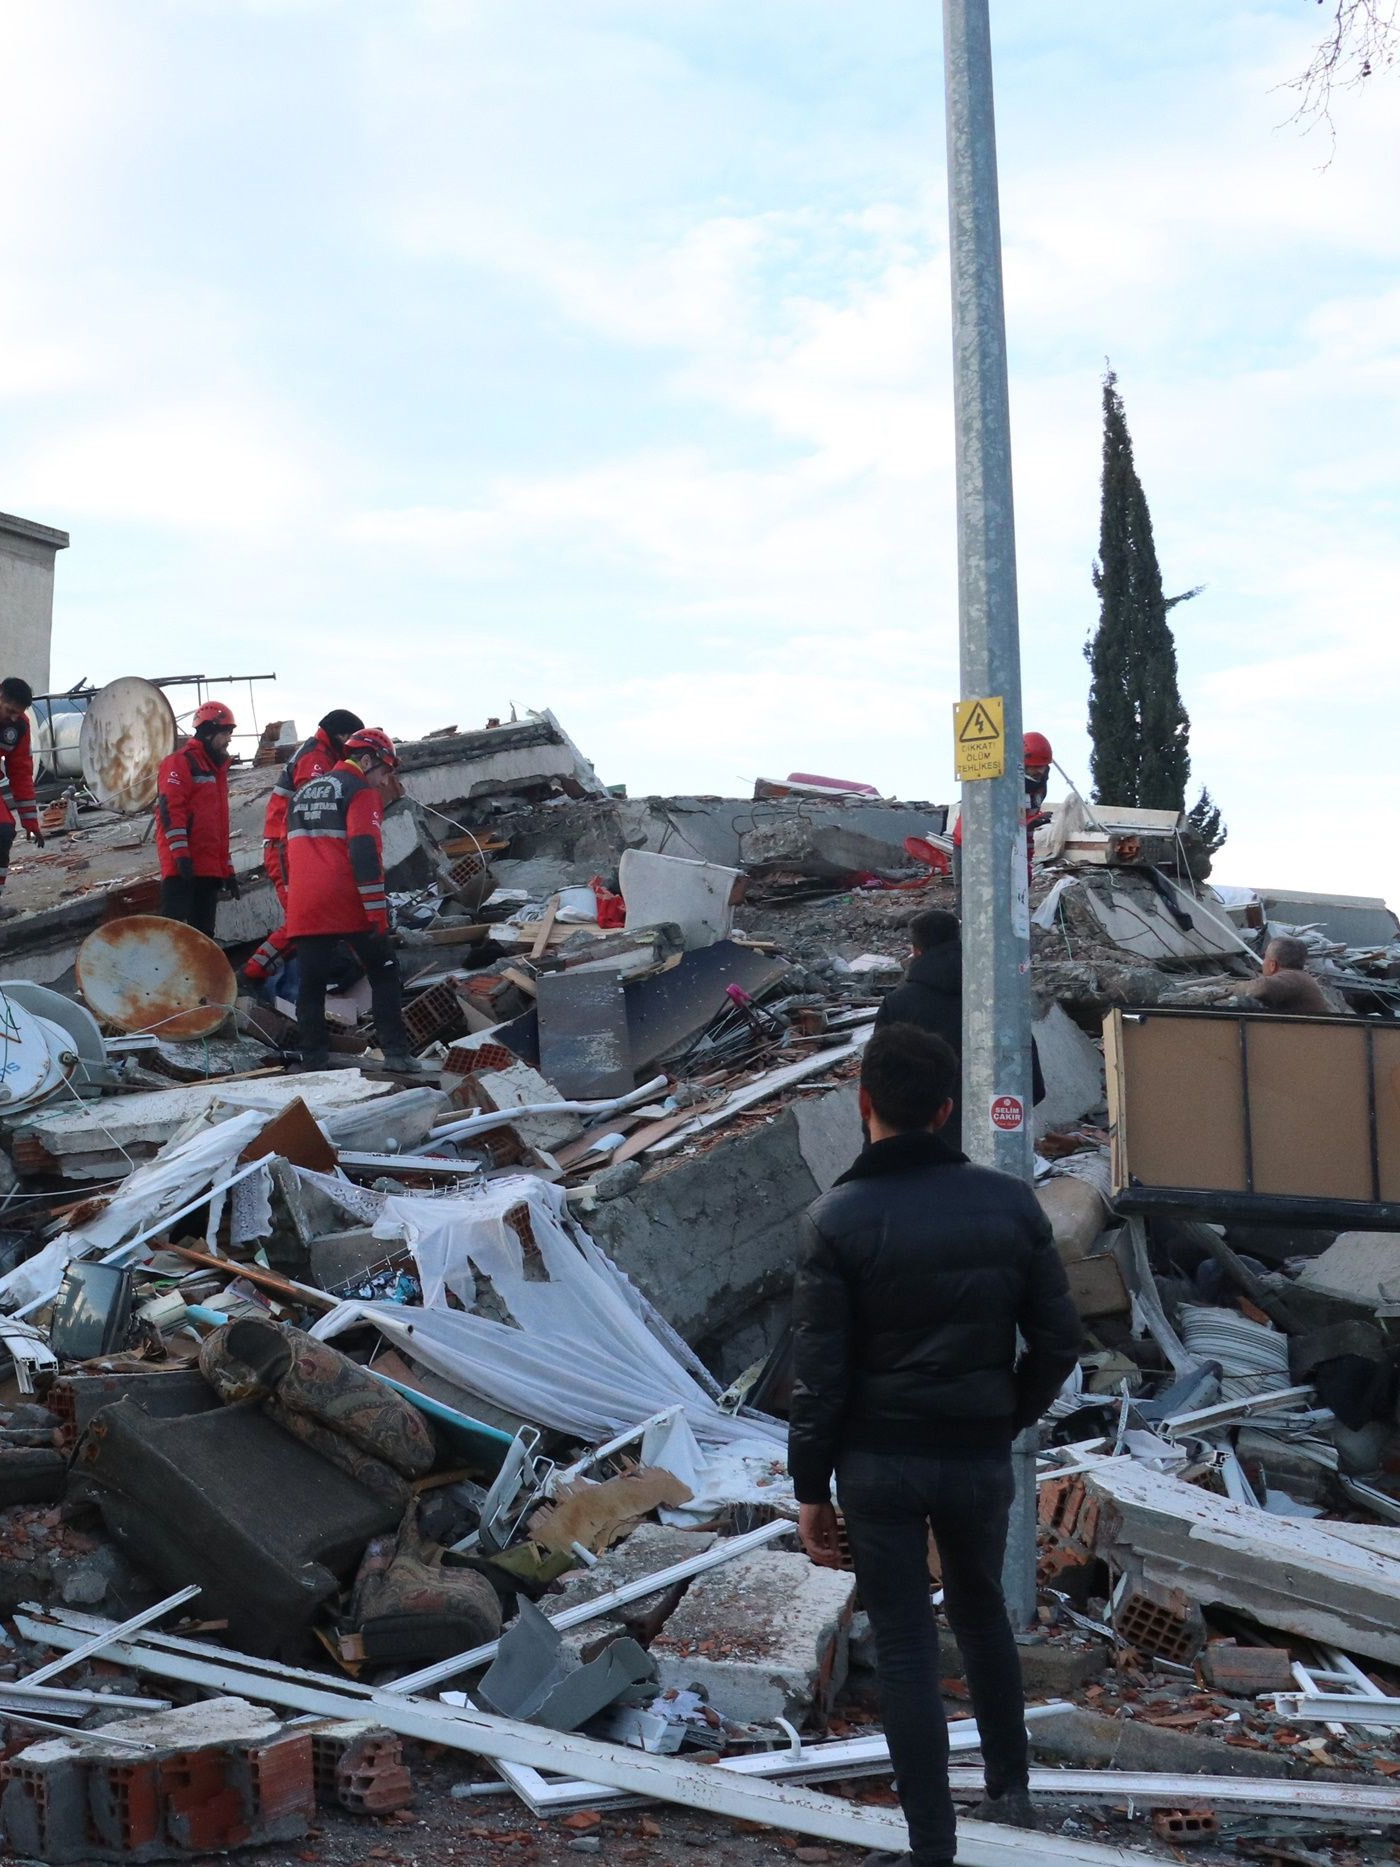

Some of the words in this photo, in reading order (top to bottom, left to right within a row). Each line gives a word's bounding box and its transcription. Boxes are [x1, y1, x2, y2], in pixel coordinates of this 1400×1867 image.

[966, 752, 991, 761] ÖLÜM
[303, 786, 332, 799] SAFE
[995, 1106, 1020, 1114] SELİM
[993, 1113, 1021, 1121] ÇAKIR
